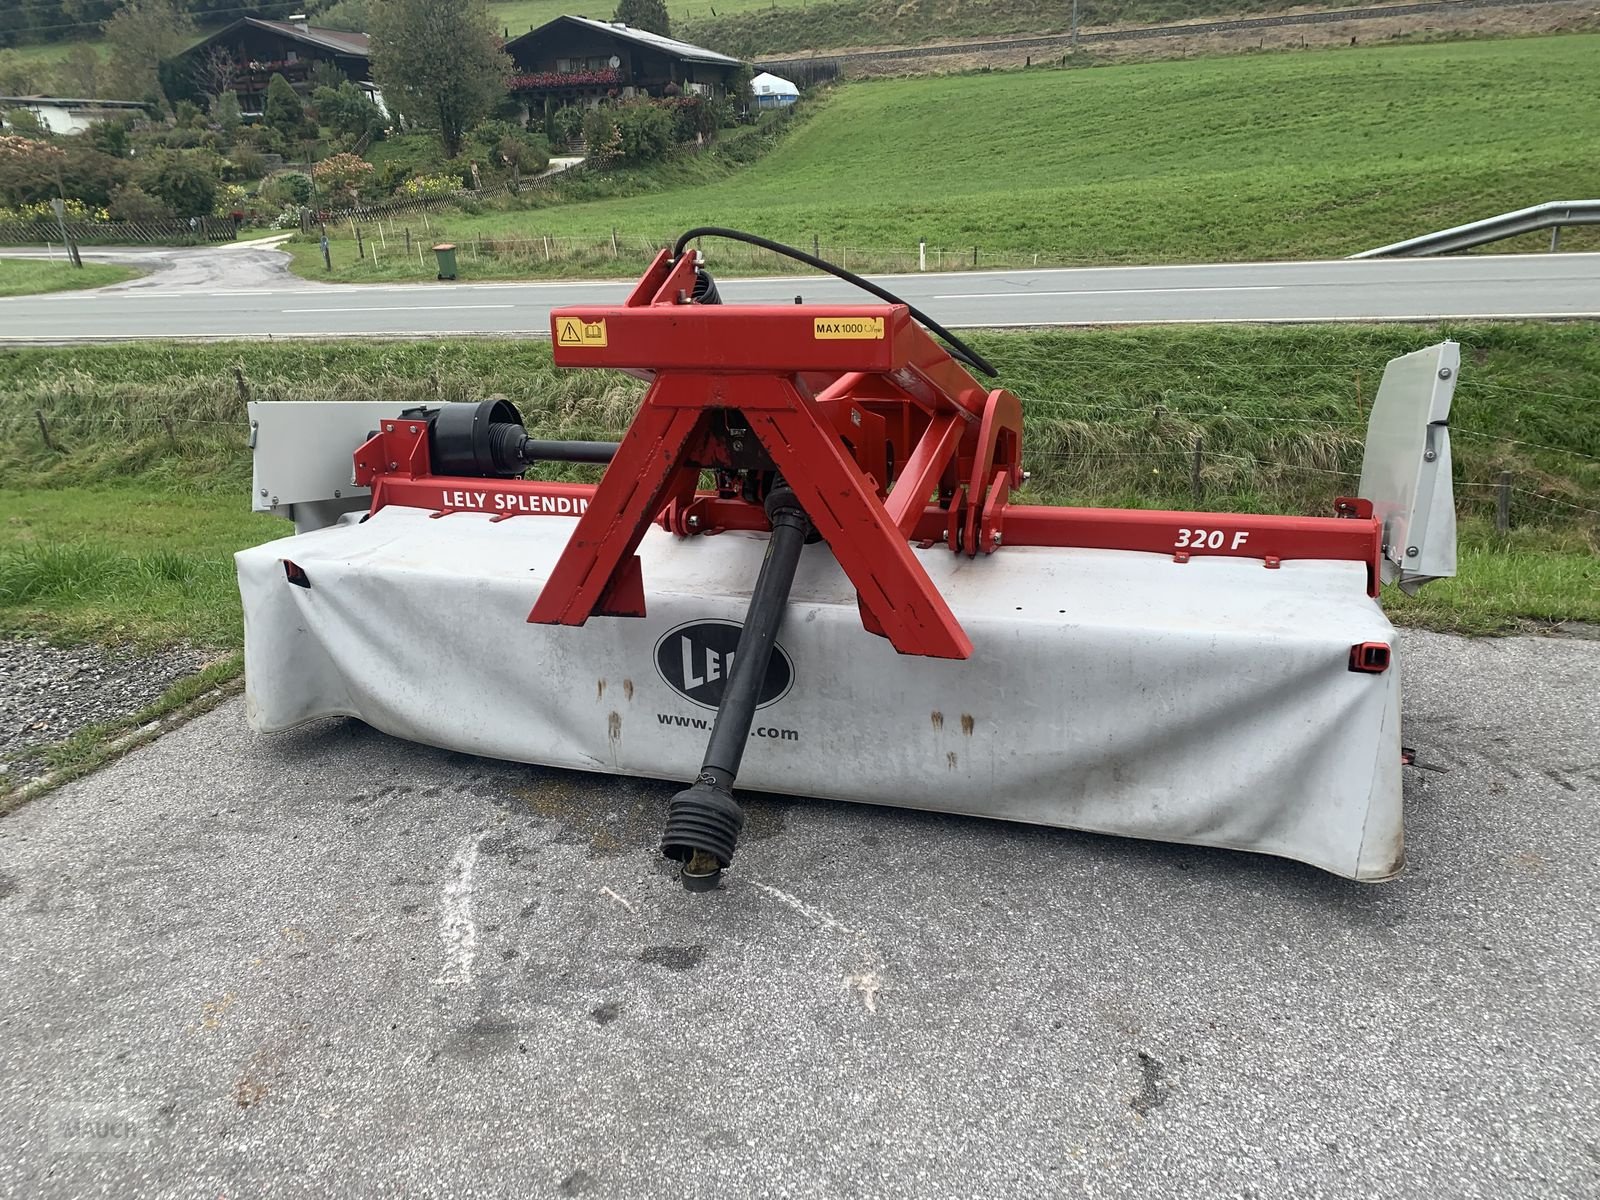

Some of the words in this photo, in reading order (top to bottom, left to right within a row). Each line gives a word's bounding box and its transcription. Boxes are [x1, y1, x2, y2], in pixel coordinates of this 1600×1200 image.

[816, 324, 840, 334] MAX
[841, 324, 863, 334] 1000
[442, 490, 486, 508] LELY
[1174, 528, 1225, 549] 320
[1230, 531, 1250, 550] F
